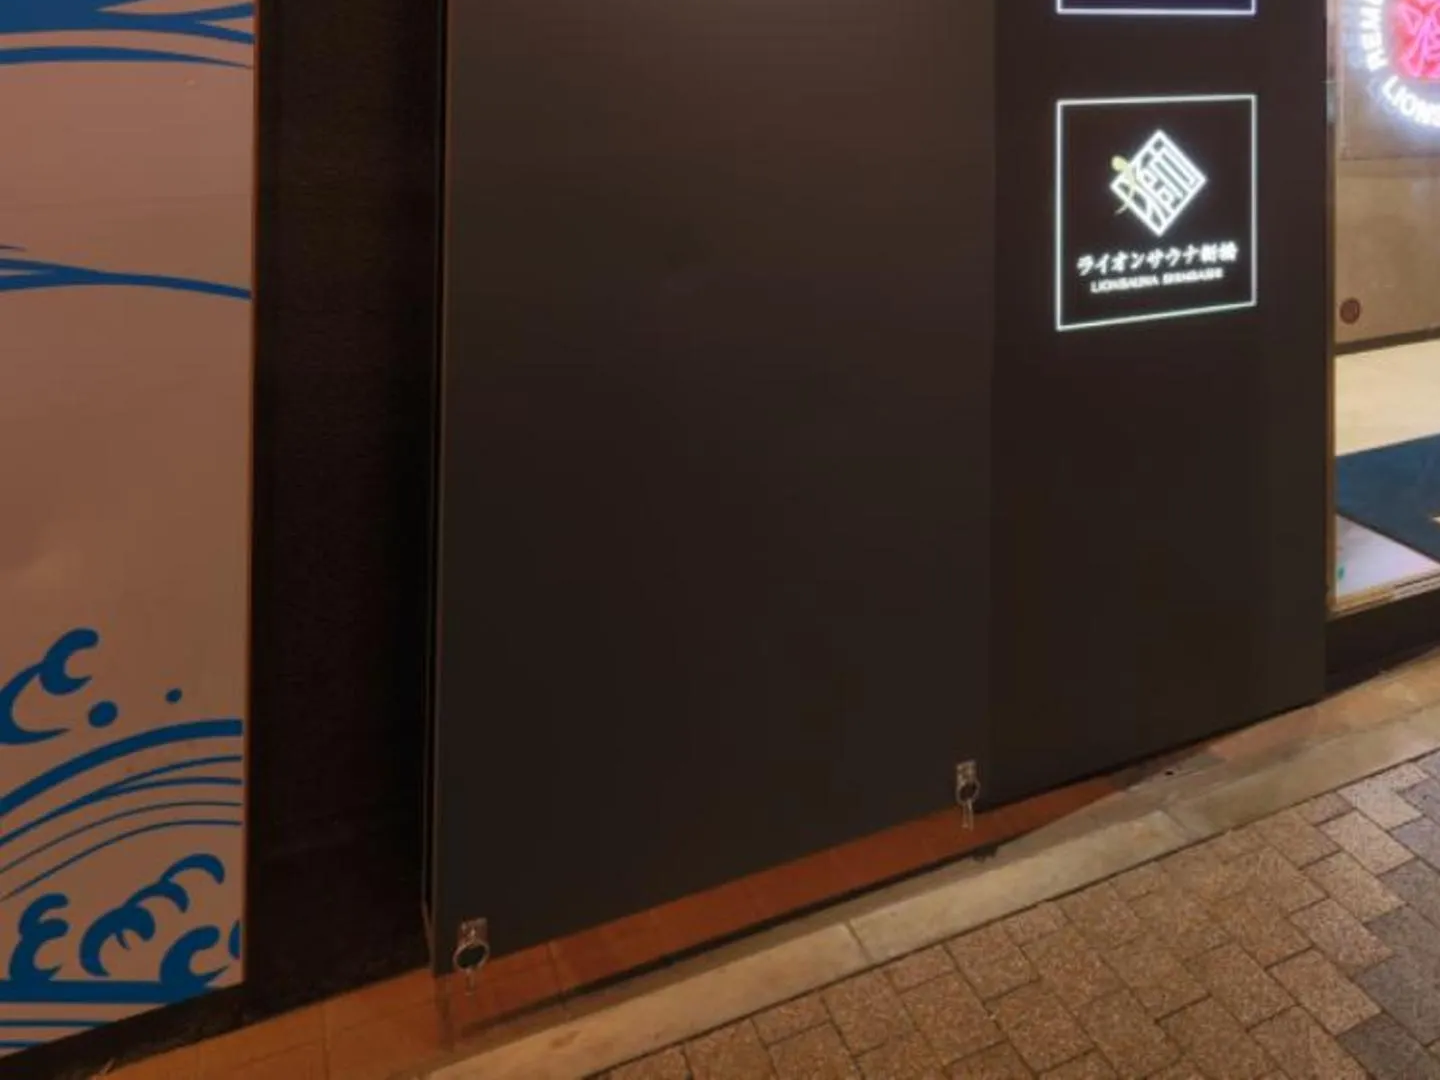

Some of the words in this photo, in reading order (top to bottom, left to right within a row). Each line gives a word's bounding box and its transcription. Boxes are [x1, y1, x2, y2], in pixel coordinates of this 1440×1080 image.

[1076, 240, 1240, 277] ライオンサウナ新橋
